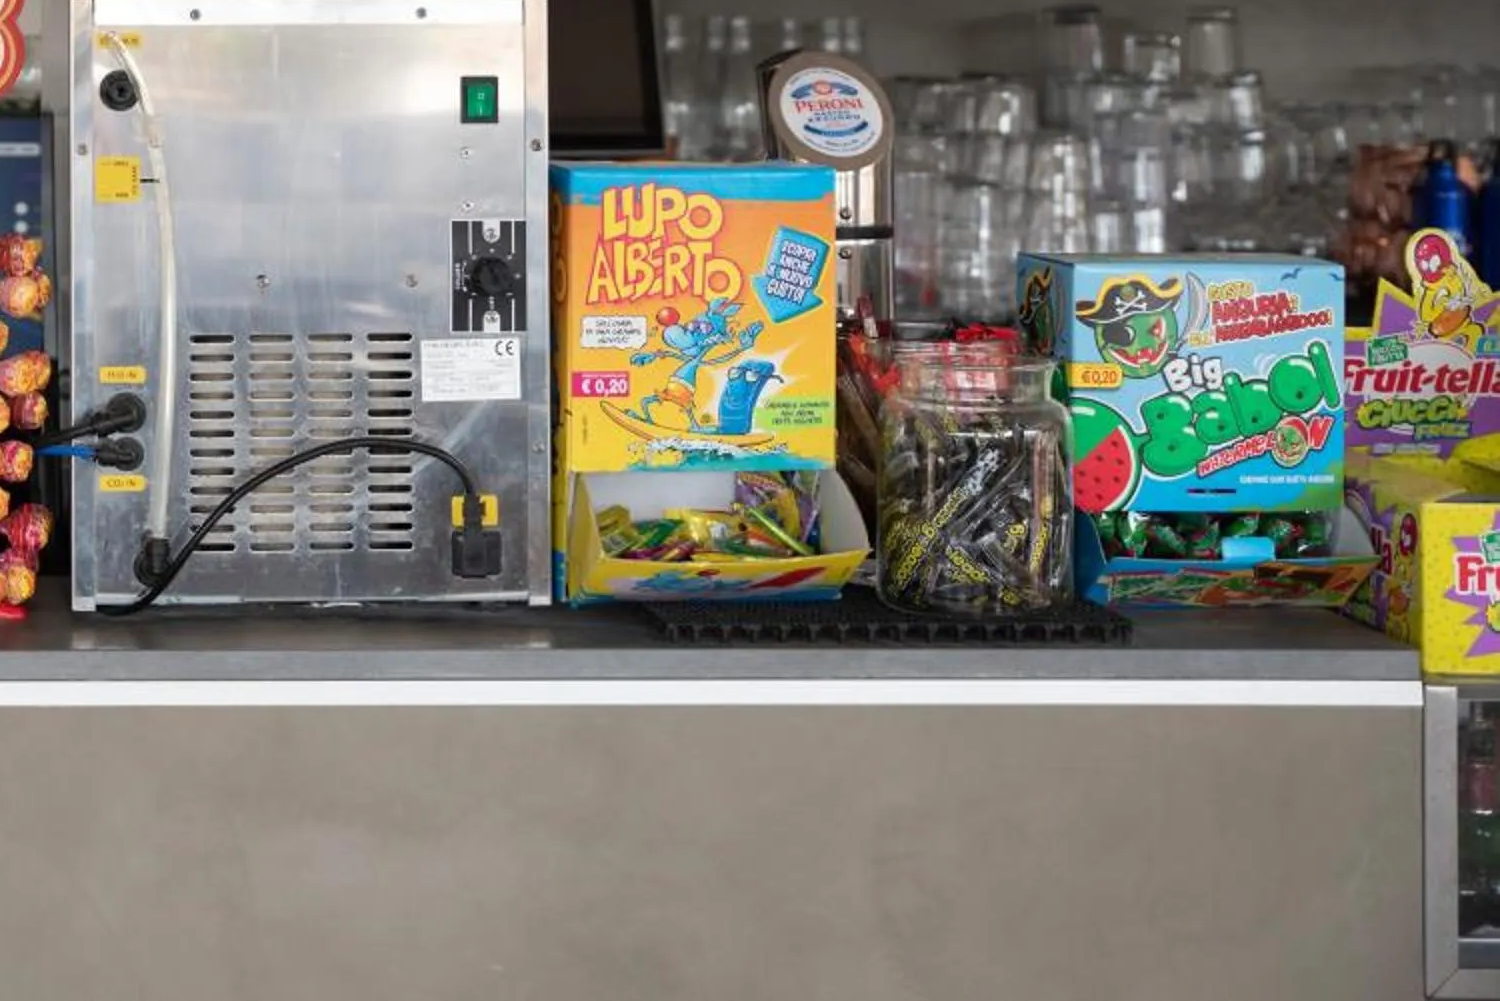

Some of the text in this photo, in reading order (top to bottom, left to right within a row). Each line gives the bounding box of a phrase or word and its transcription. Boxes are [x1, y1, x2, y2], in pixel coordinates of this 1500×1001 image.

[603, 182, 724, 241] LUPO
[586, 235, 743, 305] ALBERTO
[495, 340, 515, 356] CE
[595, 378, 628, 397] 0,20
[1163, 353, 1224, 393] Big
[1139, 340, 1342, 477] Babol
[1457, 556, 1500, 593] Fr
